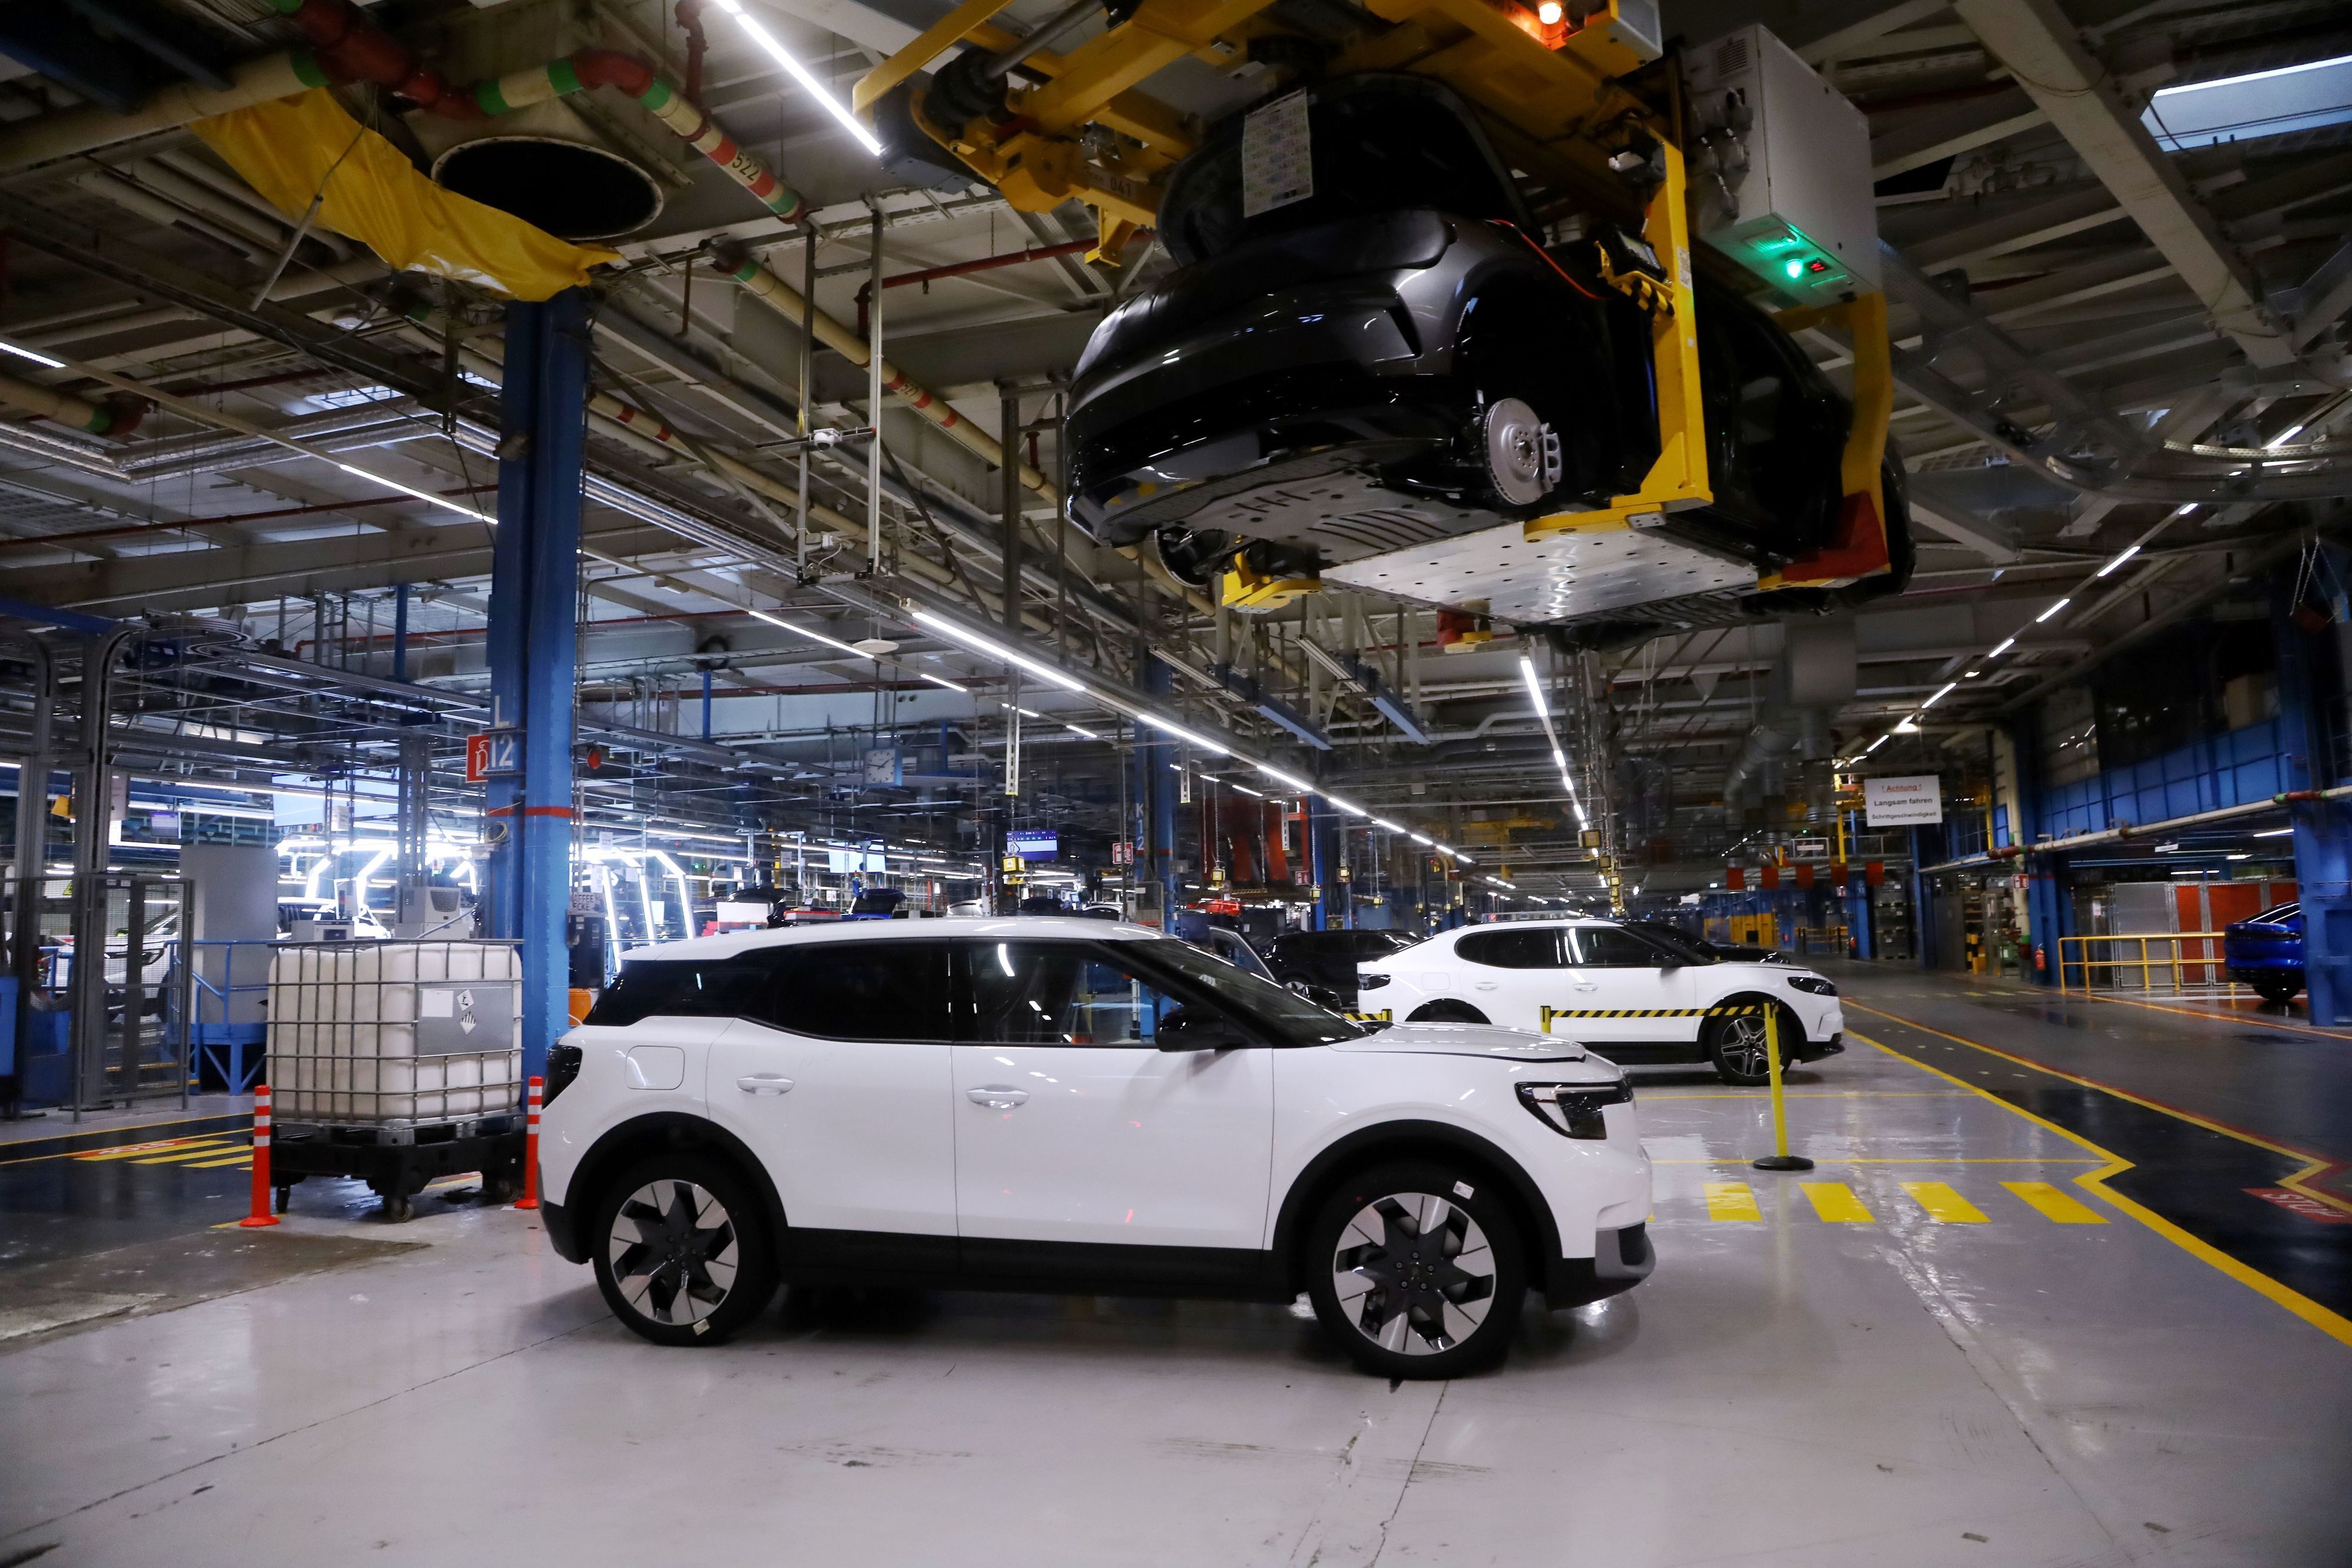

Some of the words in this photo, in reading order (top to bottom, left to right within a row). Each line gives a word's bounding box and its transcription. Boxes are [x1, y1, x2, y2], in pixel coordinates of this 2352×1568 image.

[732, 151, 759, 181] 522
[1110, 176, 1131, 198] 041
[495, 696, 510, 728] L
[490, 734, 513, 767] 12
[1886, 784, 1917, 793] Achtung
